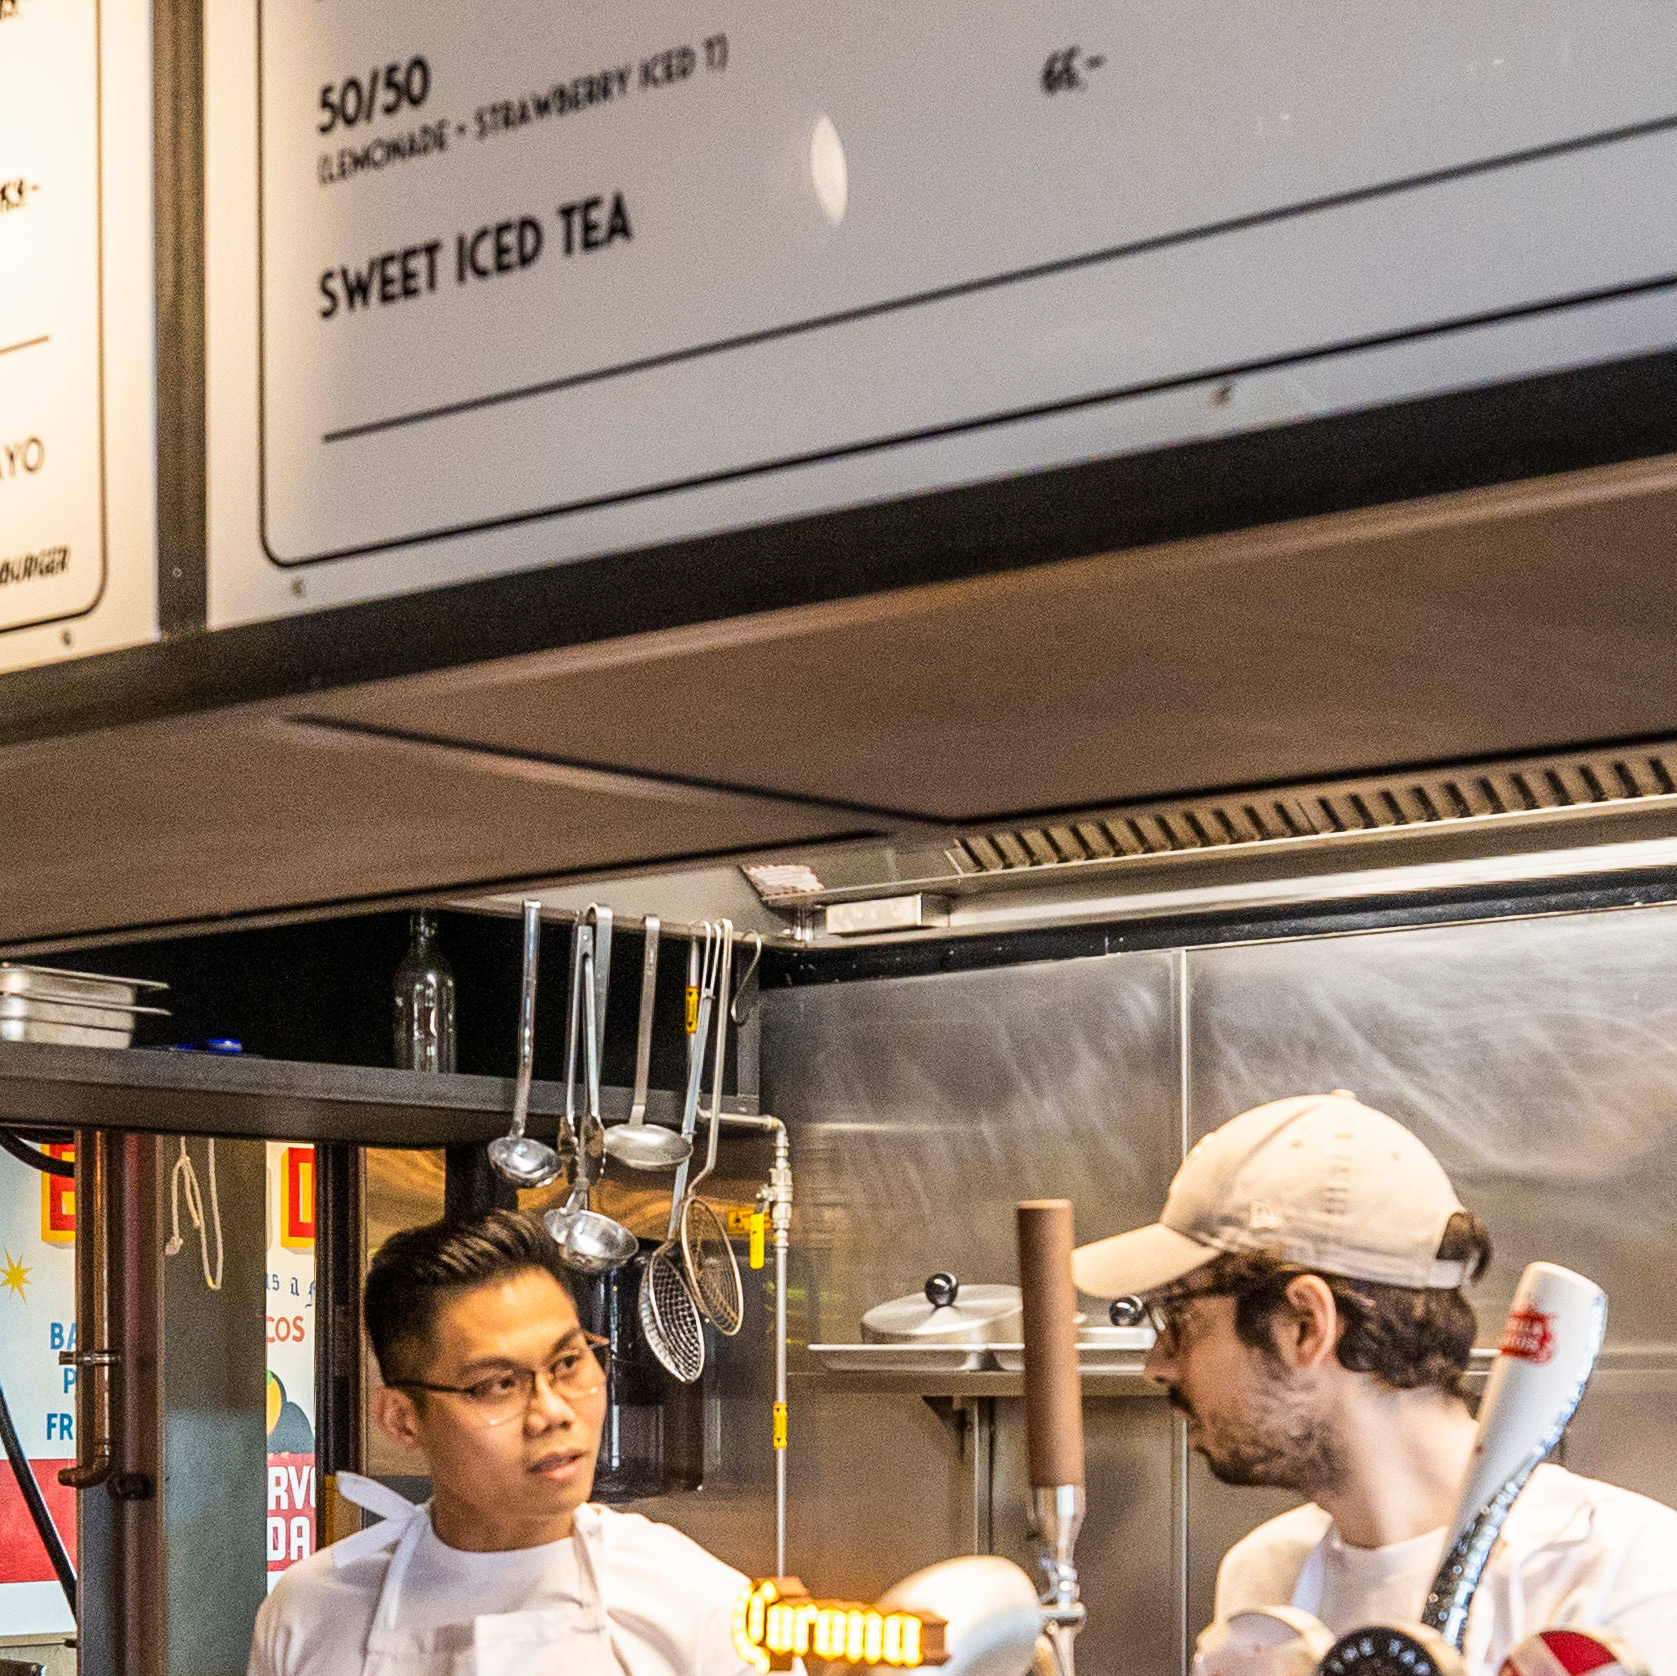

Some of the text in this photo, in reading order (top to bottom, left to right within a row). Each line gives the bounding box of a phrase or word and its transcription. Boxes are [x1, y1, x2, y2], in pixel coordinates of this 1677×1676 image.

[318, 55, 431, 134] 50/50
[473, 62, 631, 140] STRAWBERRY
[638, 45, 696, 91] ICED
[318, 191, 633, 320] SWEET ICED TEA
[732, 1579, 923, 1675] Corona
